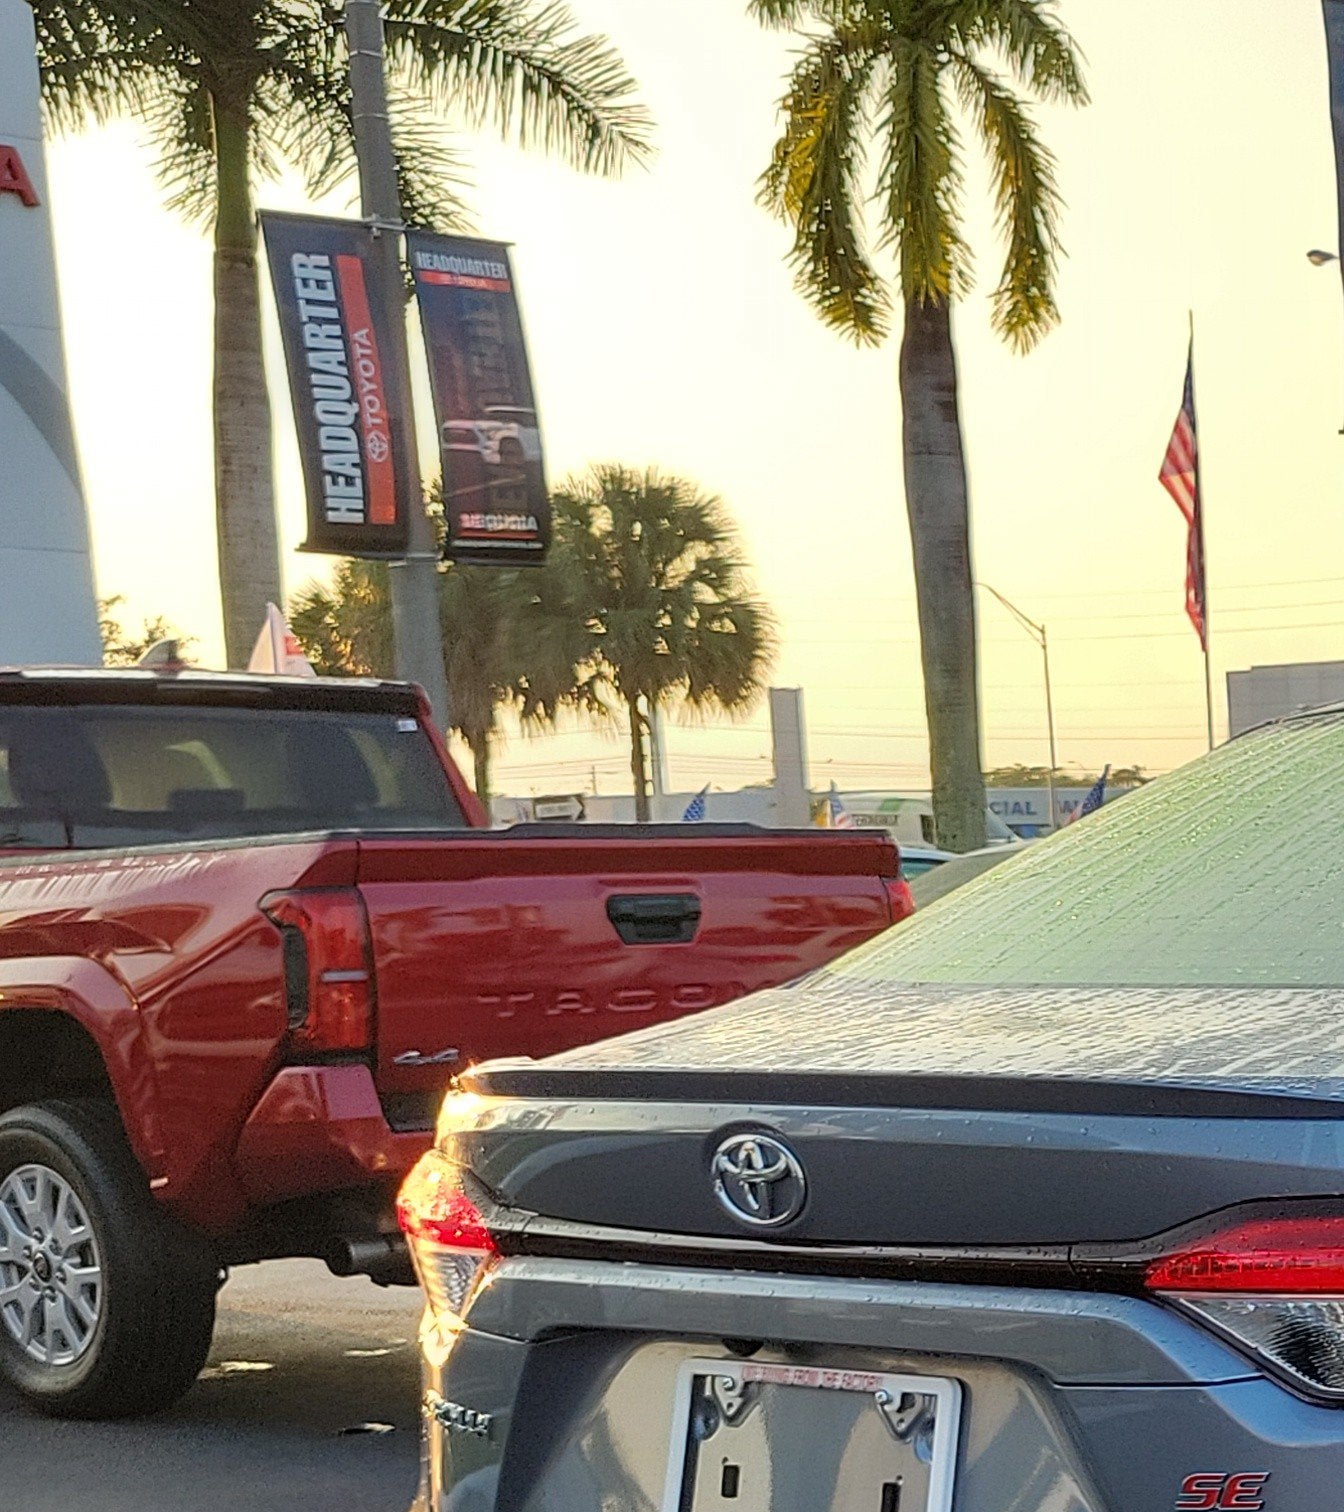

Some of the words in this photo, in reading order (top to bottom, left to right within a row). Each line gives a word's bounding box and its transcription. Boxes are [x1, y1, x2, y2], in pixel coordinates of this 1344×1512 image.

[292, 253, 365, 524] HEADQUARTER
[352, 328, 387, 426] TOYOTA
[1175, 1471, 1270, 1511] SE
